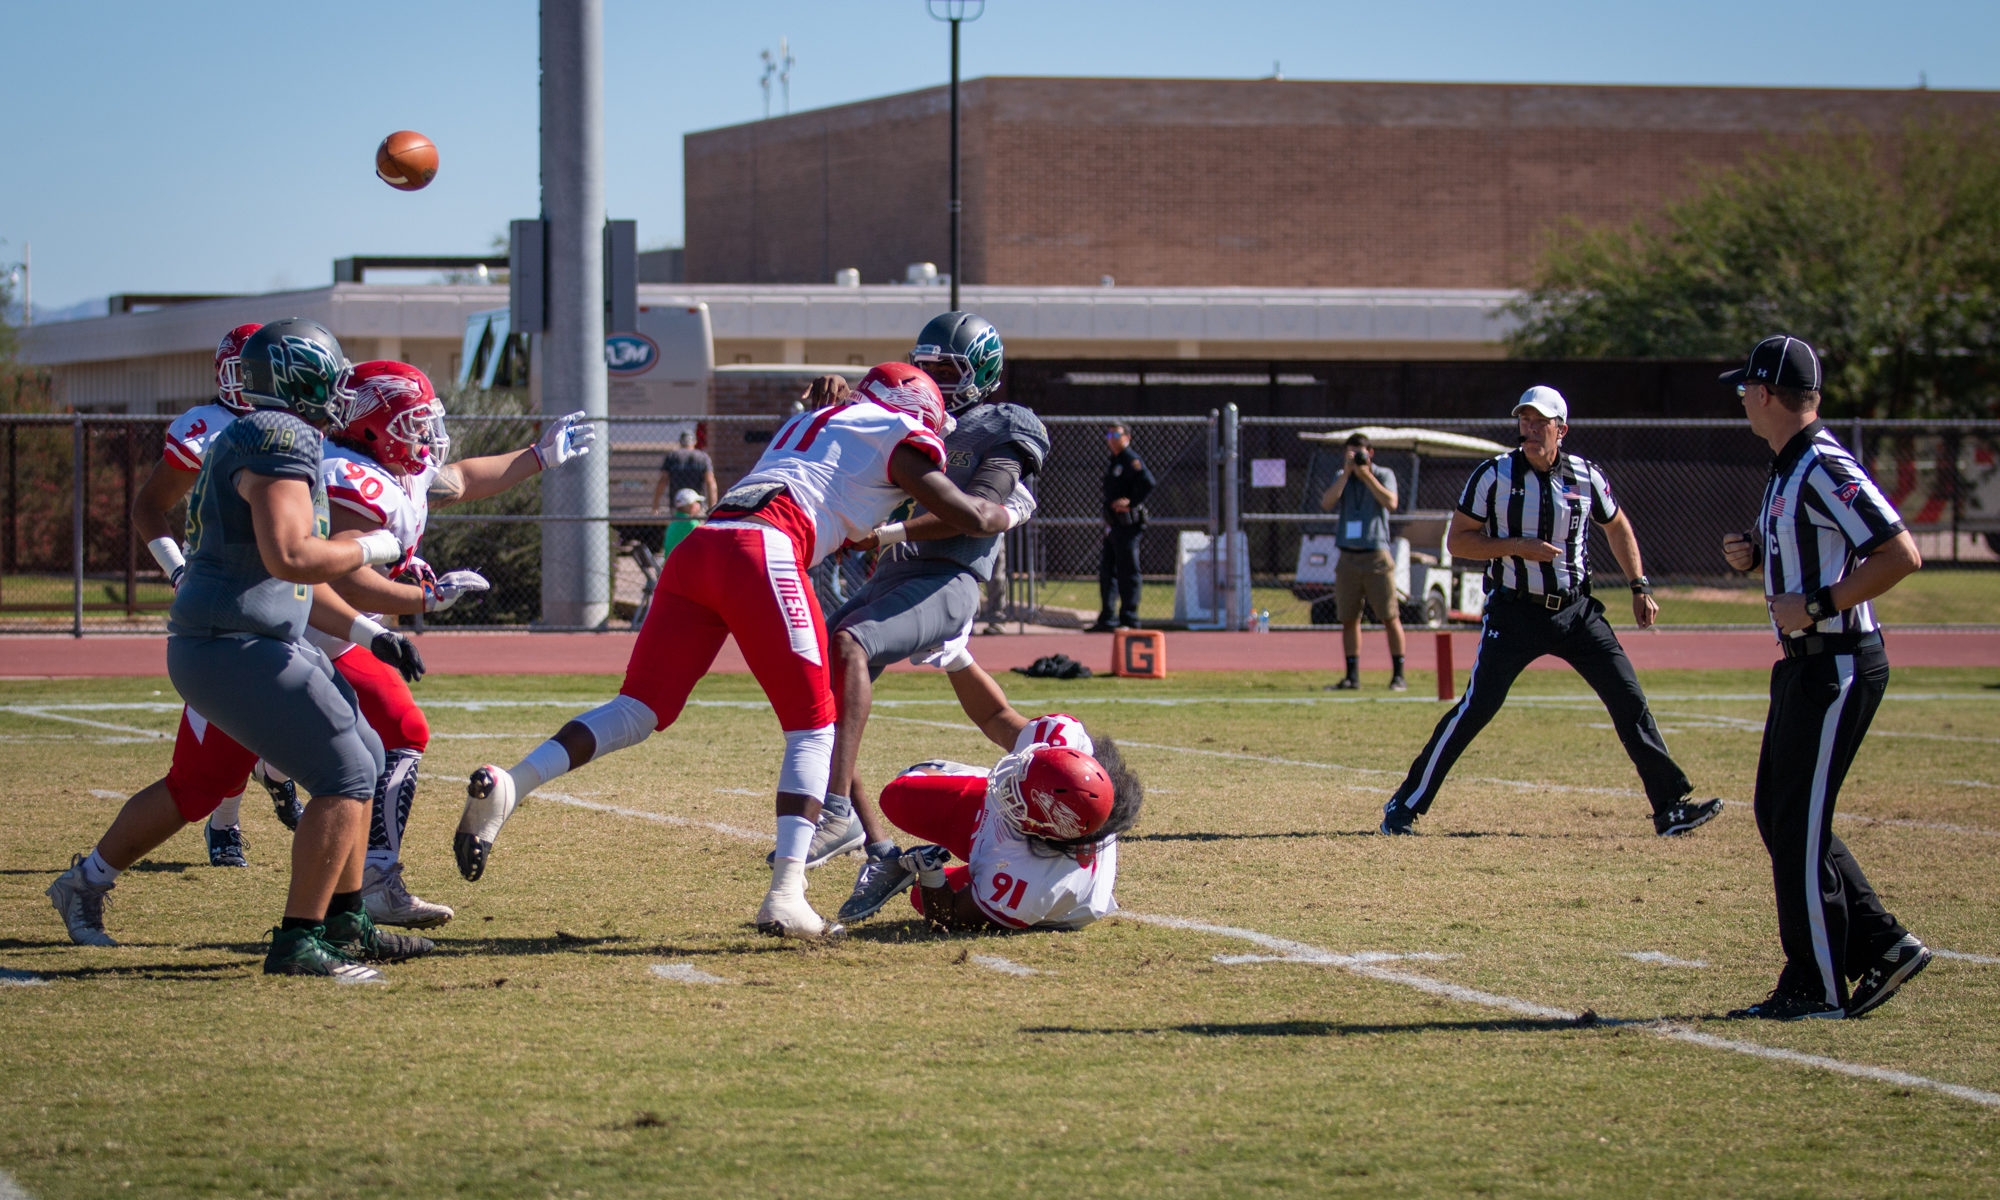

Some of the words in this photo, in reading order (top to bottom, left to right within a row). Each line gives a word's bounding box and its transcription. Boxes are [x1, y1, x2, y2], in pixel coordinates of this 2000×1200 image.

[184, 418, 208, 438] 3
[259, 427, 296, 452] 79
[773, 405, 850, 453] 11
[343, 461, 384, 501] 90
[1569, 515, 1580, 530] R
[1769, 533, 1780, 555] C
[775, 577, 810, 629] MESA
[1125, 635, 1155, 674] G
[989, 872, 1029, 911] 91
